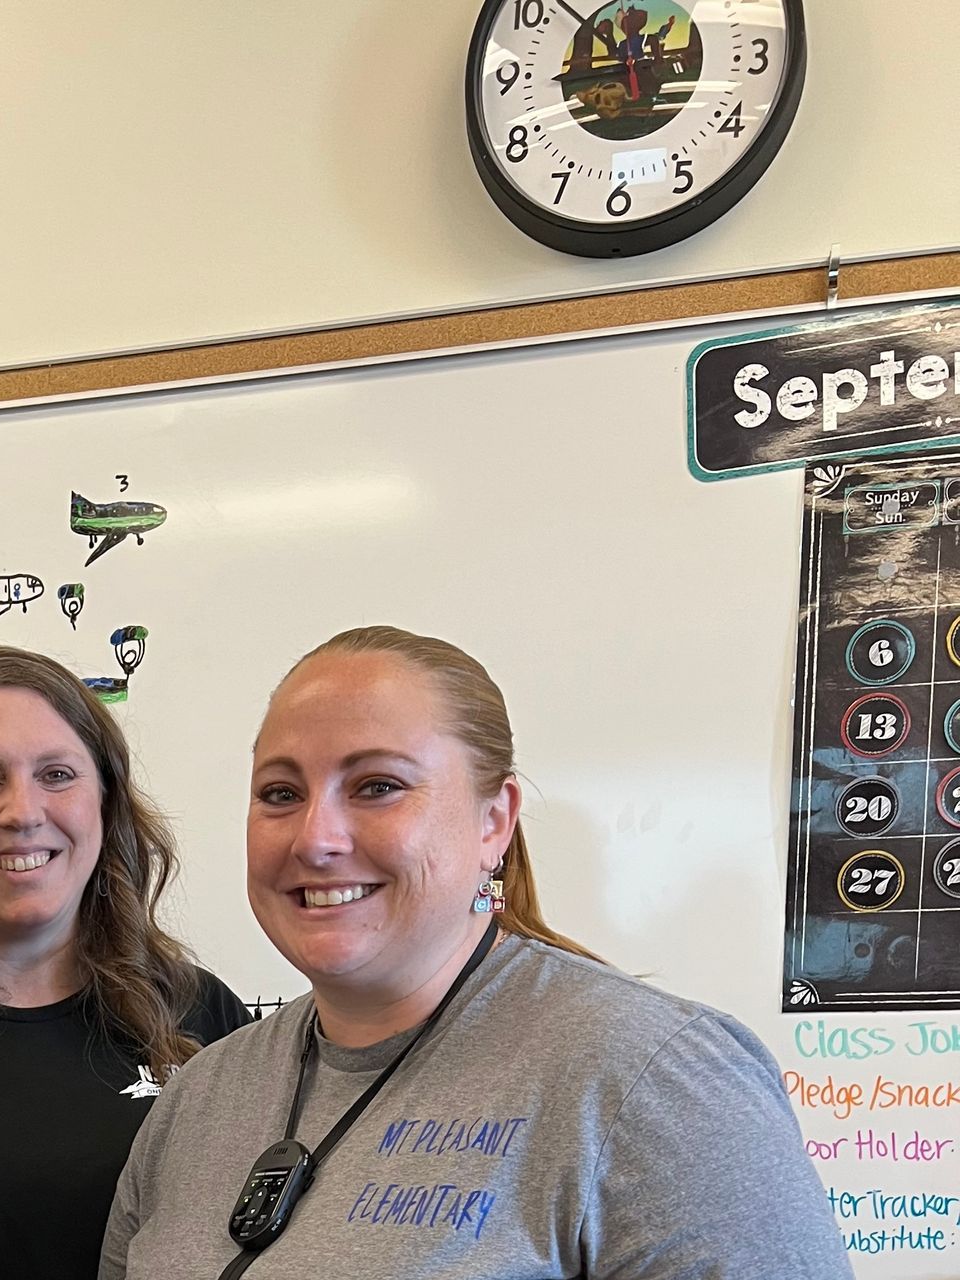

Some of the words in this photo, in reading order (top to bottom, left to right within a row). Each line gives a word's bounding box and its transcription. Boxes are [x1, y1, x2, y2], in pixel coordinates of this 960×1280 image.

[513, 0, 543, 30] 10
[748, 38, 769, 75] 3
[496, 61, 520, 96] 9
[717, 101, 745, 138] 4
[505, 125, 529, 163] 8
[551, 171, 572, 205] 7
[672, 160, 695, 194] 5
[606, 180, 632, 217] 6
[733, 350, 960, 432] Septe
[115, 474, 130, 493] 3
[865, 489, 920, 508] Sunday
[875, 511, 907, 525] Sun.
[868, 639, 894, 667] 6
[855, 713, 898, 741] 13
[845, 795, 892, 823] 20
[848, 868, 897, 896] 27
[795, 1020, 896, 1060] Class
[378, 1119, 421, 1157] MT
[411, 1116, 528, 1157] PLEASANT
[806, 1138, 848, 1160] oor
[348, 1182, 496, 1240] ELEMENTARY
[839, 1225, 956, 1254] ubstitute:
